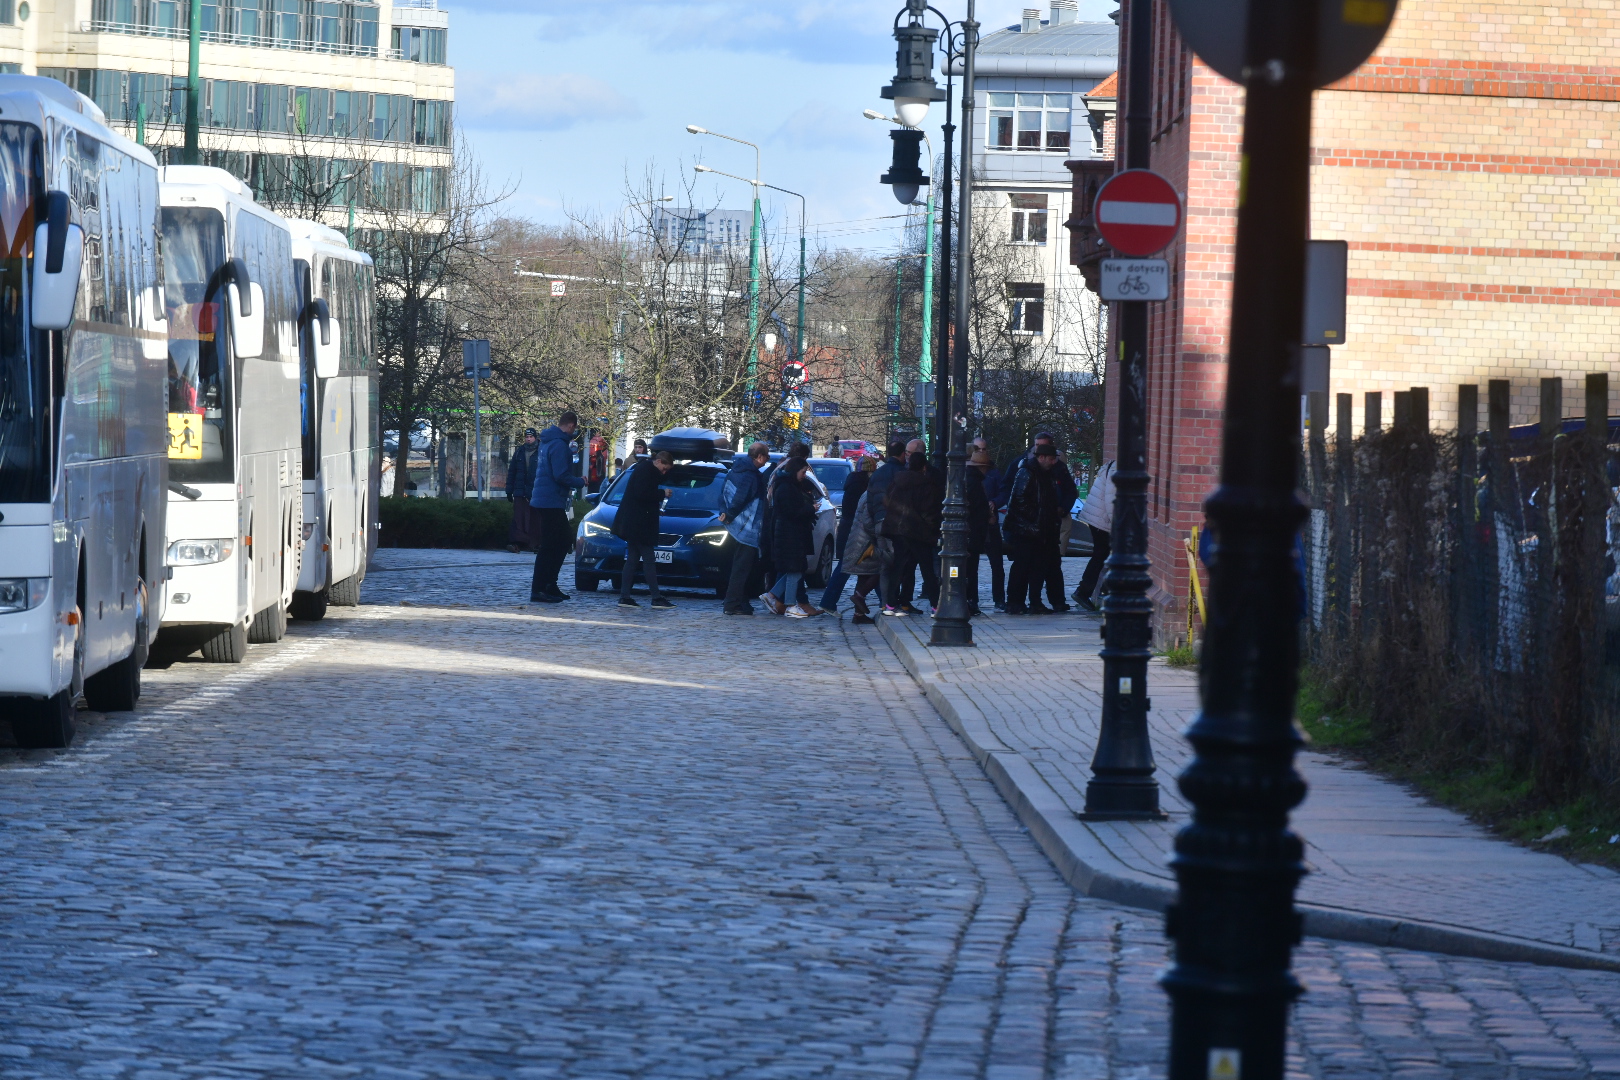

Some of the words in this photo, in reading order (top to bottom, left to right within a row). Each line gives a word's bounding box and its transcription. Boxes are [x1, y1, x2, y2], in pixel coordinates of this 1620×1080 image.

[1105, 264, 1122, 273] Nie
[1128, 264, 1166, 275] dotyczy
[553, 284, 564, 292] 20
